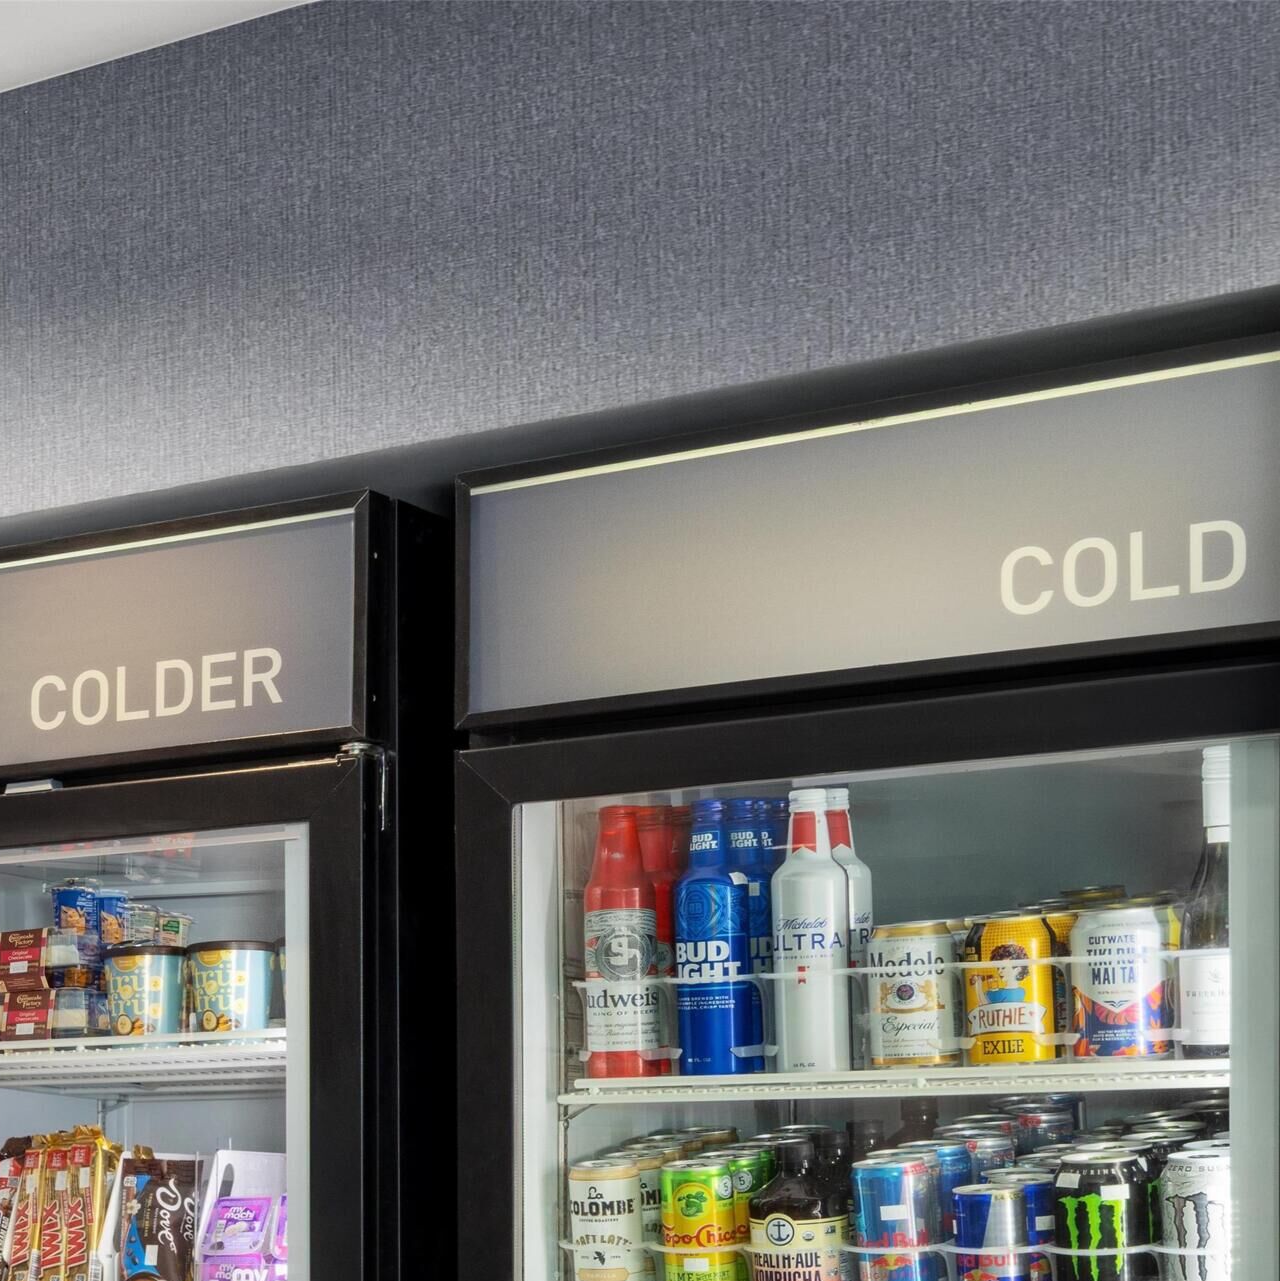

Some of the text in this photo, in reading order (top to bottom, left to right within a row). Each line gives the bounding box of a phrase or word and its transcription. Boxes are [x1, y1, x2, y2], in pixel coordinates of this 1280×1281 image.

[1000, 518, 1247, 617] COLD
[31, 646, 284, 733] COLDER
[777, 919, 827, 930] Michelob
[979, 1006, 1026, 1026] RUTHIE
[983, 1039, 1024, 1054] EXILE
